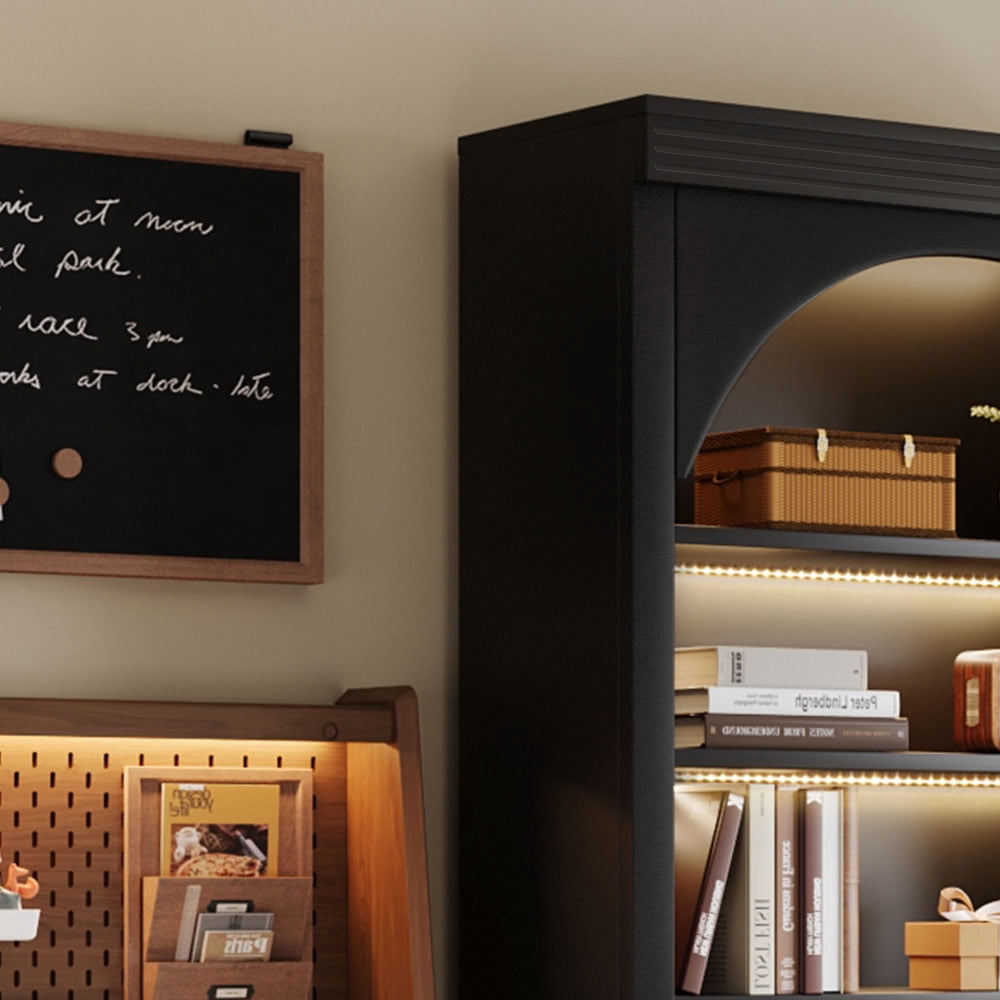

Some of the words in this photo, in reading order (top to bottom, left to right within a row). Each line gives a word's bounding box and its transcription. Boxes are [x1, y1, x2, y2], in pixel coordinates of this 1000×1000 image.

[75, 199, 120, 225] at
[126, 322, 140, 341] 3
[78, 370, 117, 389] at
